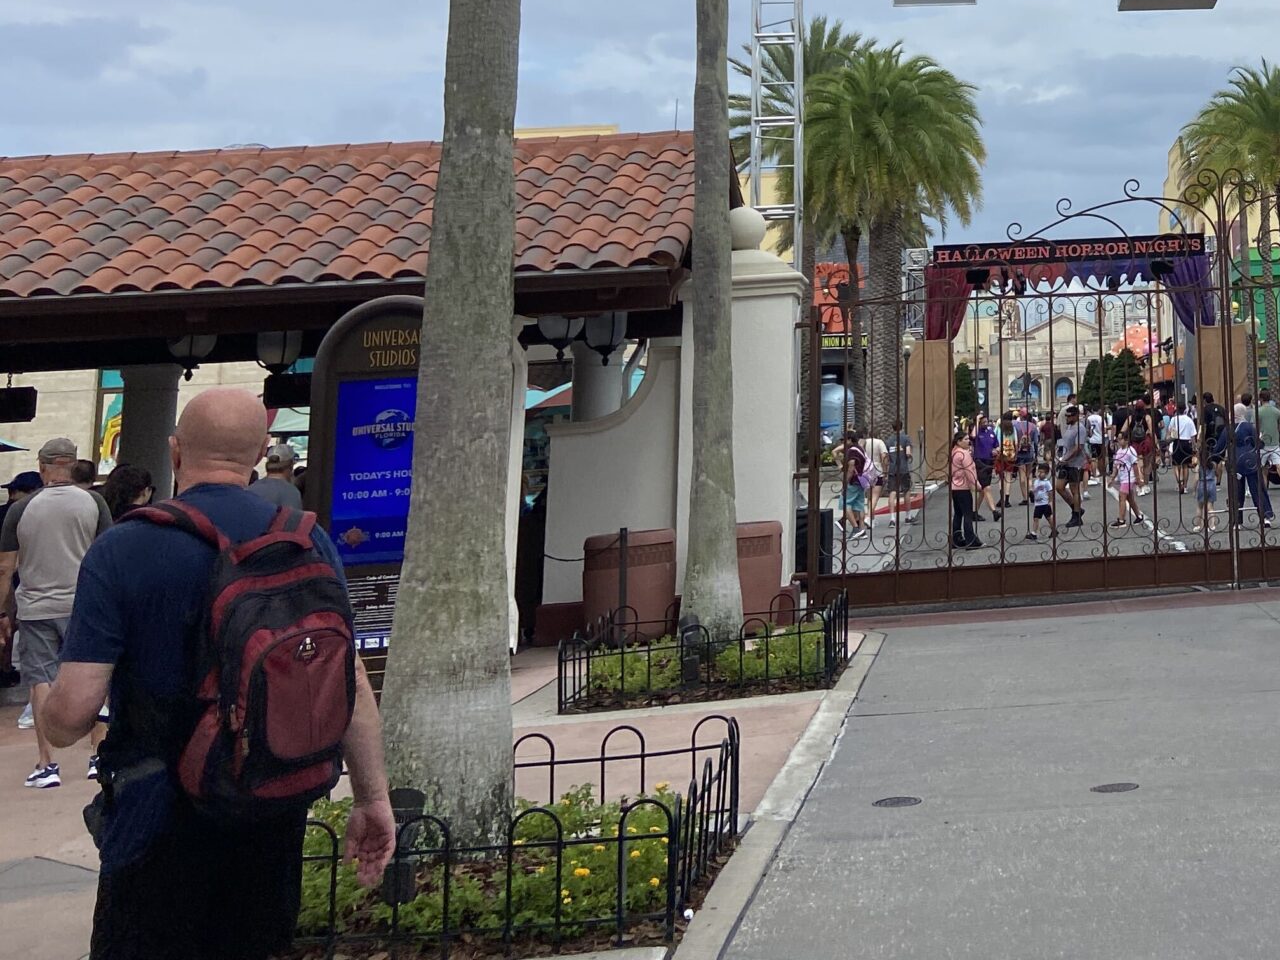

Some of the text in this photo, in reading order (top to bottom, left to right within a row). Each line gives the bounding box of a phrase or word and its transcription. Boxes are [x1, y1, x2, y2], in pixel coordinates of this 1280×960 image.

[936, 238, 1201, 263] HALLOWEEN HORROR NIGHTS
[821, 336, 840, 347] INION
[369, 348, 416, 368] STUDIOS
[352, 423, 395, 436] UNIVERSAL
[375, 431, 406, 439] FLORIDA
[350, 470, 391, 481] TODAY'S
[342, 490, 369, 500] 10:00
[371, 489, 387, 498] AM
